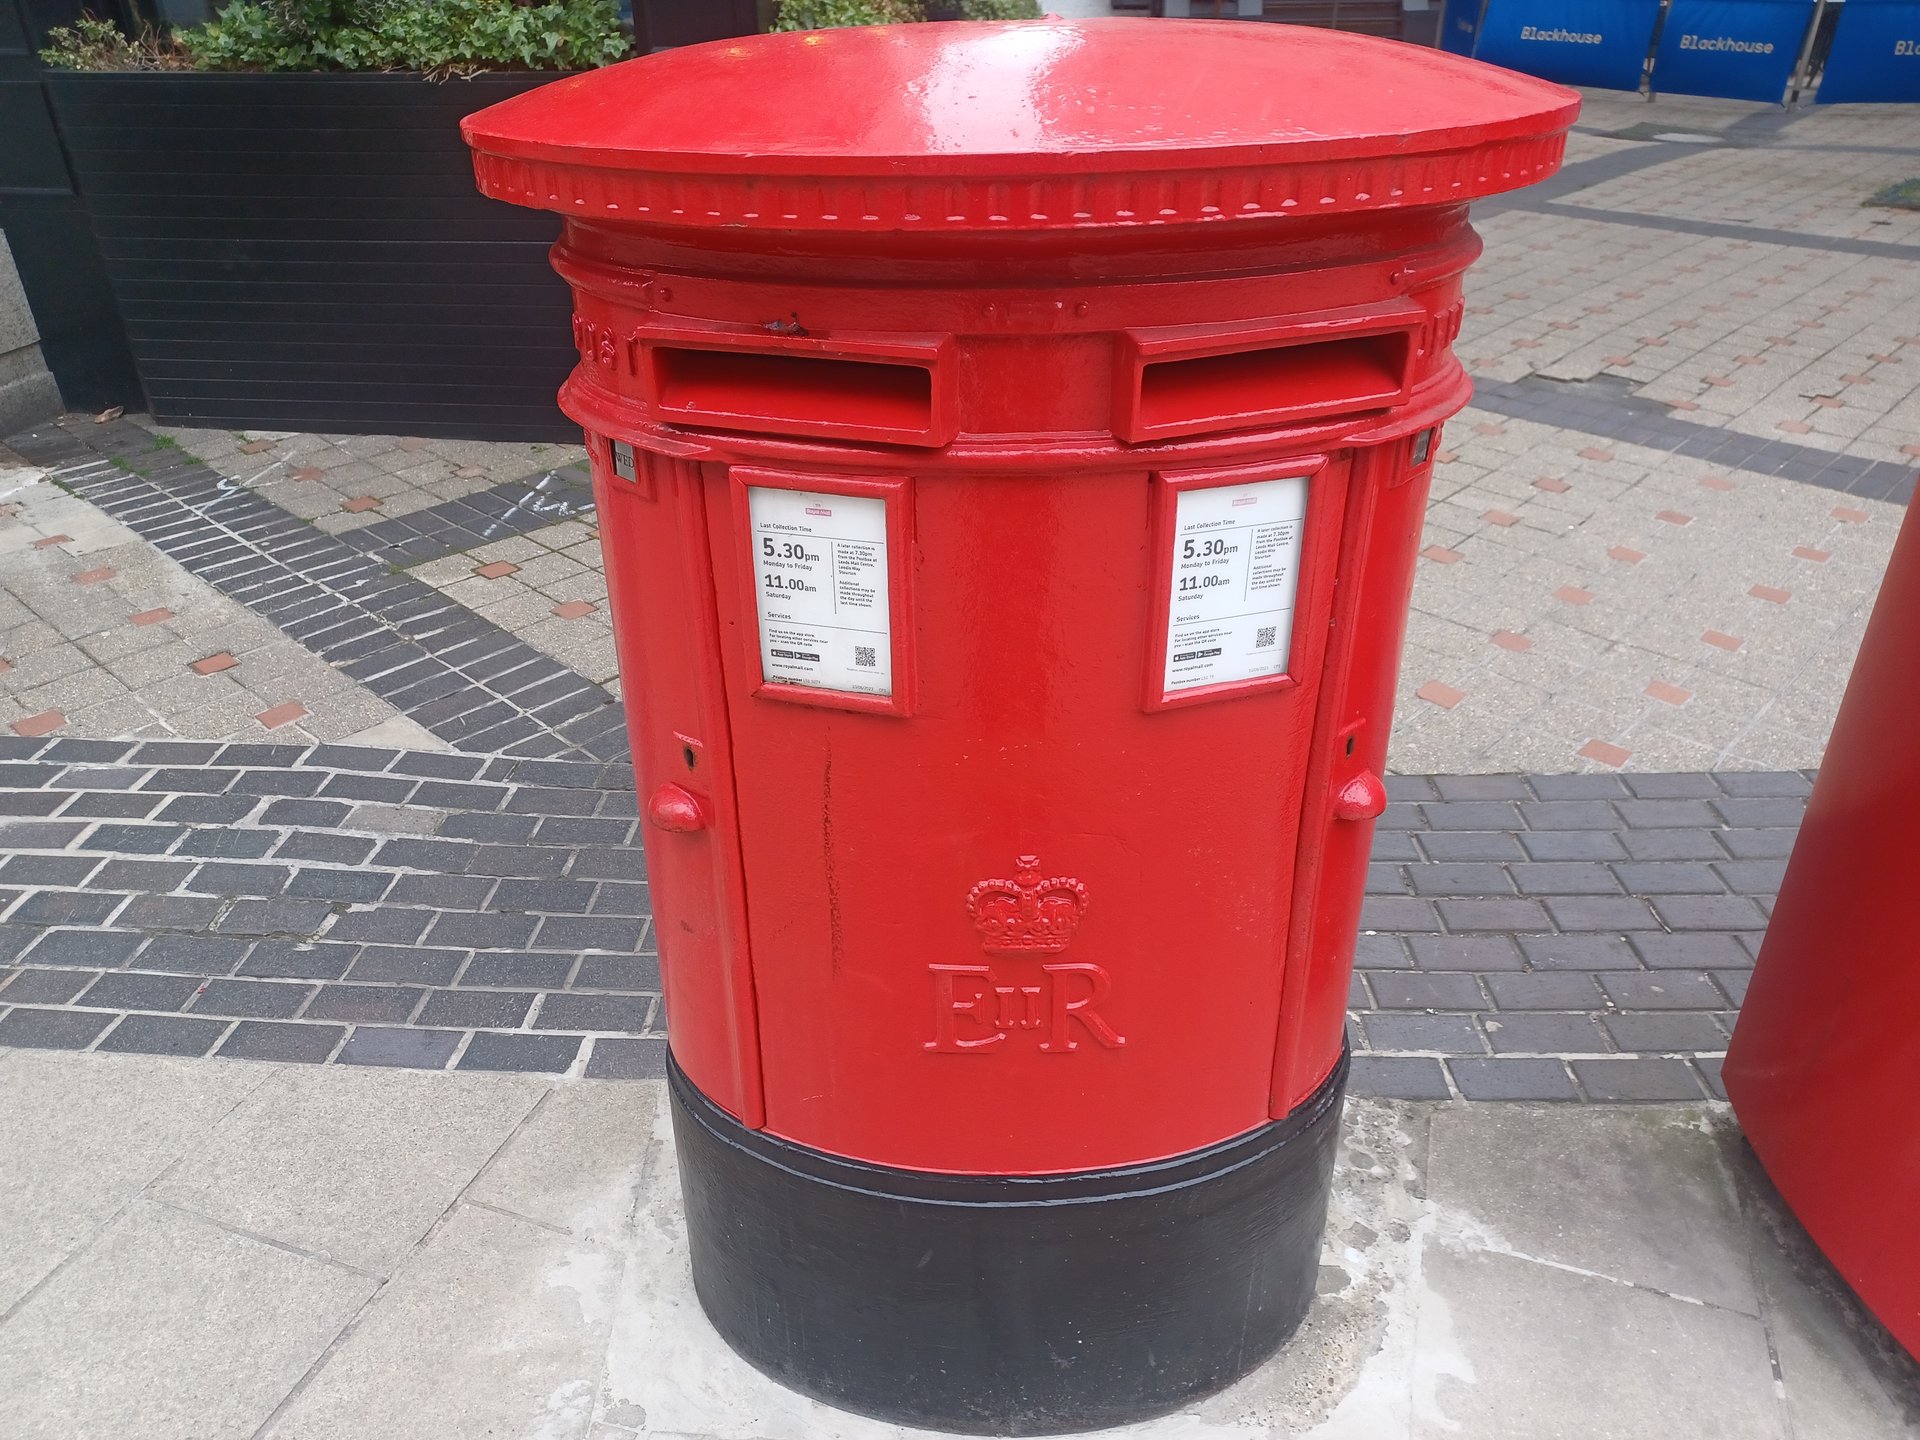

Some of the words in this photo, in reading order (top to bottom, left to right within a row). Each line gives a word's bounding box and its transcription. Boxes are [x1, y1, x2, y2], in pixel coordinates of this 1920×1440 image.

[1520, 26, 1602, 44] Blackhouse
[1680, 34, 1774, 54] Blackhouse
[615, 452, 635, 468] WED
[764, 538, 820, 562] 5.30pm
[1184, 539, 1238, 558] 5.30pm
[764, 560, 785, 568] Monday
[795, 563, 812, 571] Friday
[764, 574, 816, 592] 11.00am
[1180, 575, 1230, 591] 11.00am
[766, 592, 791, 600] Saturday
[768, 612, 792, 620] Services
[1172, 664, 1214, 672] www.royalmail.com
